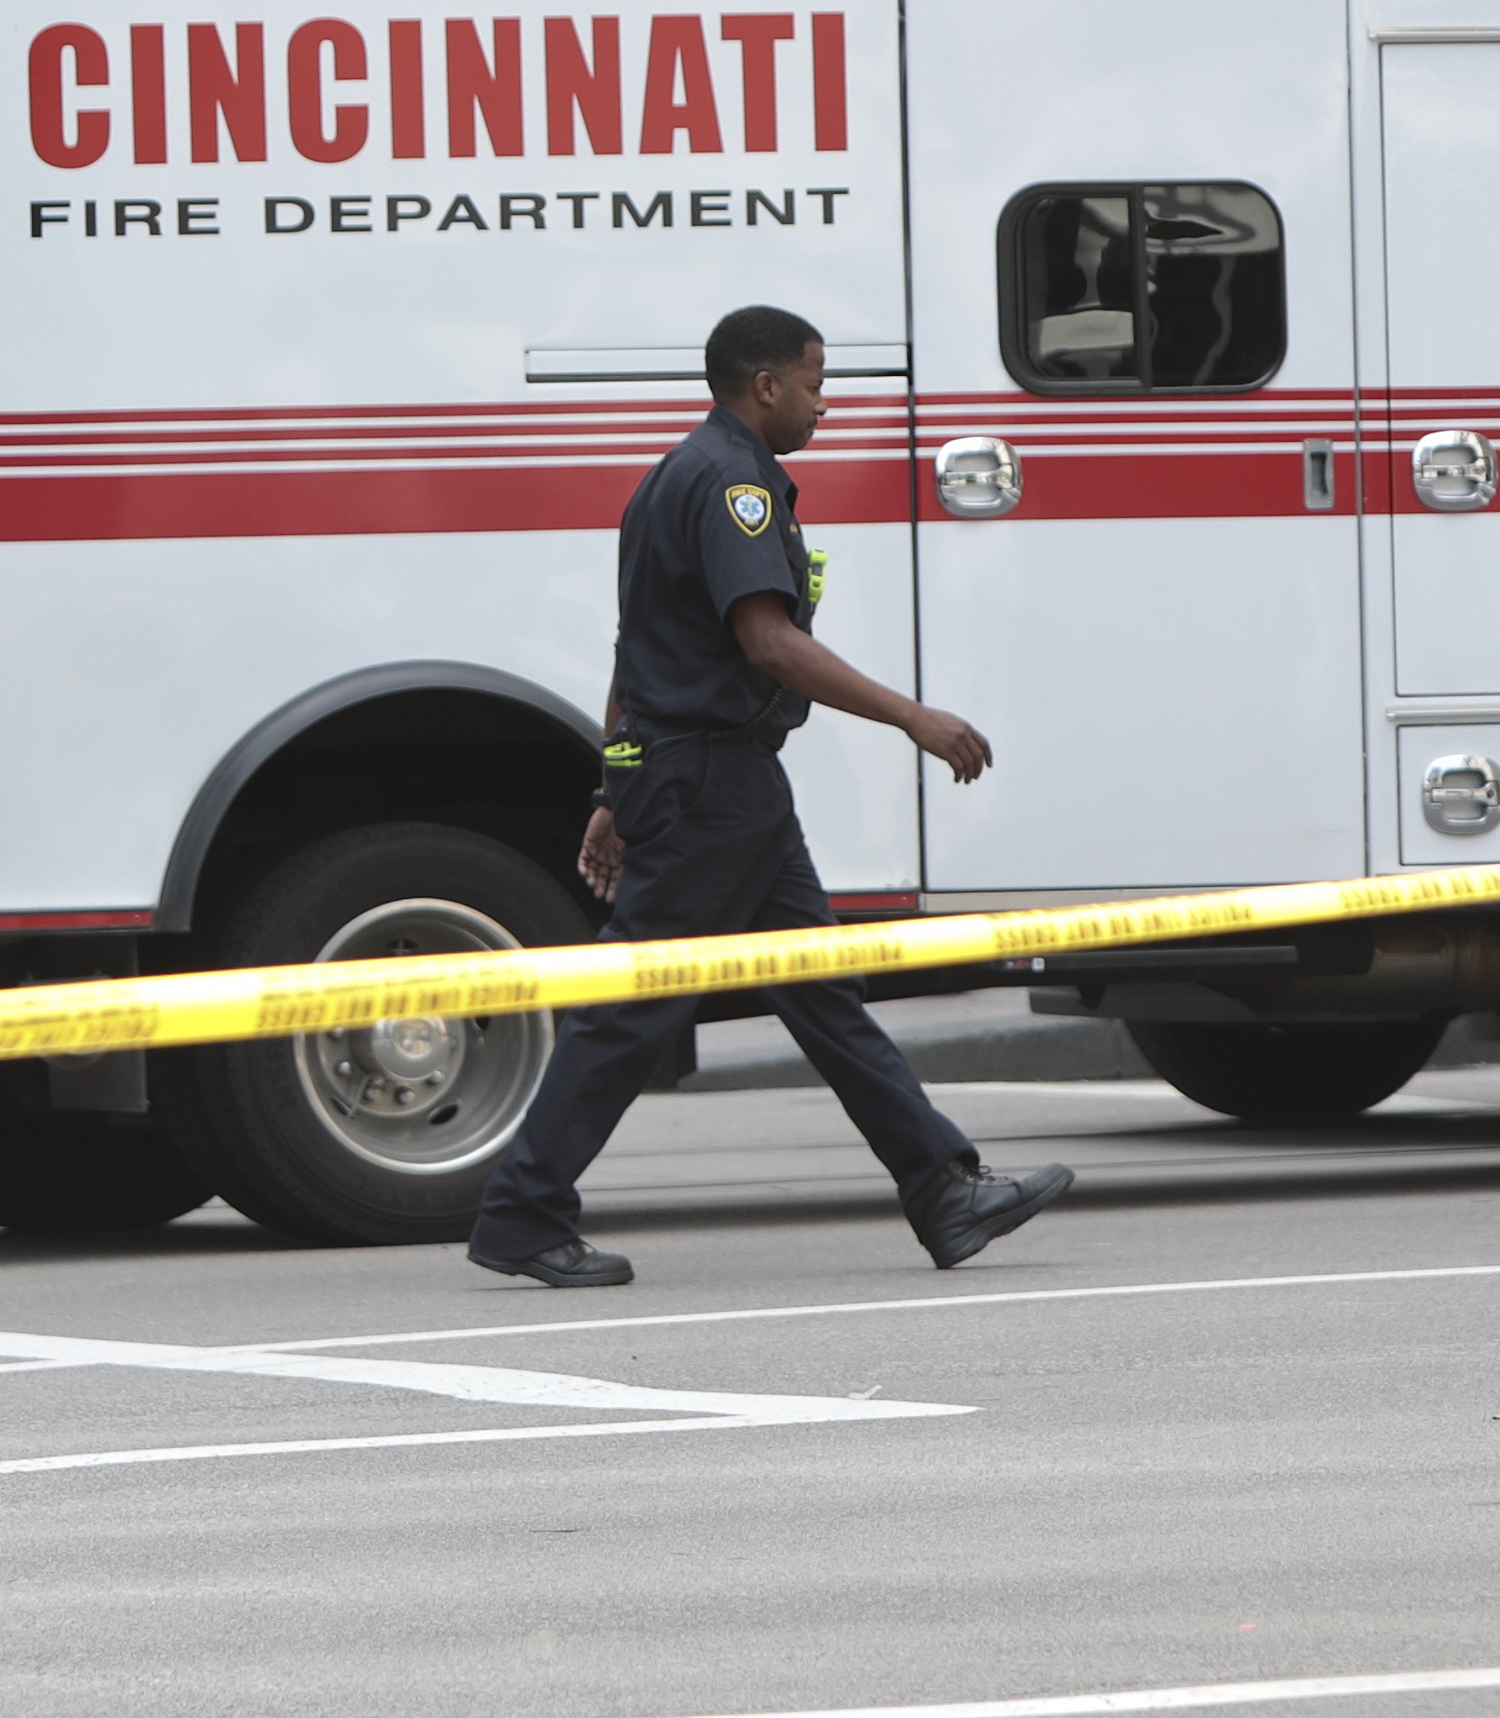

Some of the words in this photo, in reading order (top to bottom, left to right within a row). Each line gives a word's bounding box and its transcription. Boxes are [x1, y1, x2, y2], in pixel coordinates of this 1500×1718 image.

[28, 11, 849, 170] CINCINNATI
[29, 196, 221, 239] FIRE
[264, 186, 851, 235] DEPARTMENT
